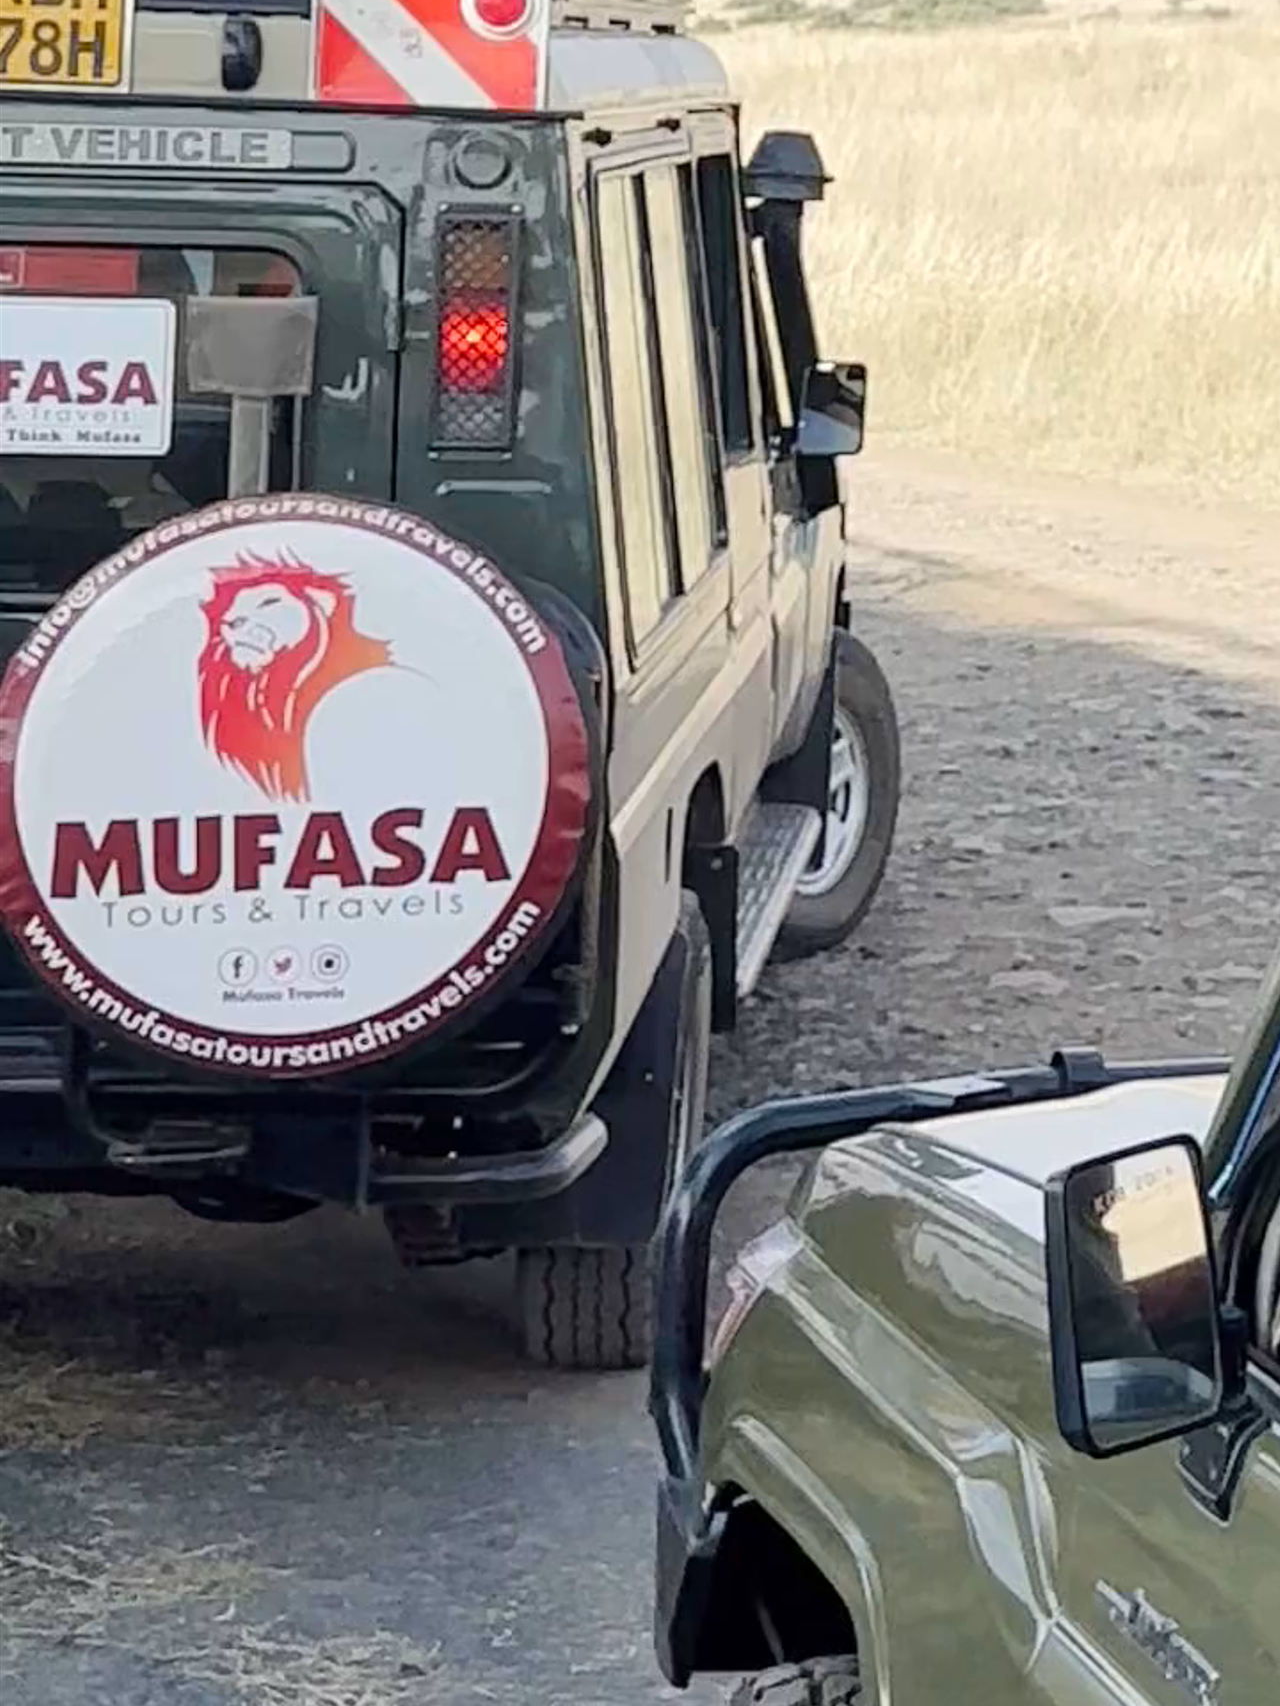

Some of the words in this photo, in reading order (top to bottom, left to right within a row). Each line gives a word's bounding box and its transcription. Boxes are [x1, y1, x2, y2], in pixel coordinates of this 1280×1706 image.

[0, 18, 106, 78] 78H
[50, 127, 269, 164] VEHICLE
[50, 806, 512, 899] MUFASA
[101, 898, 227, 928] Tours
[248, 897, 274, 922] &
[294, 889, 465, 922] Travels
[22, 899, 542, 1068] www.mufasatoursandtravels.com
[222, 989, 283, 1003] Mufasa
[288, 987, 346, 1001] Travels
